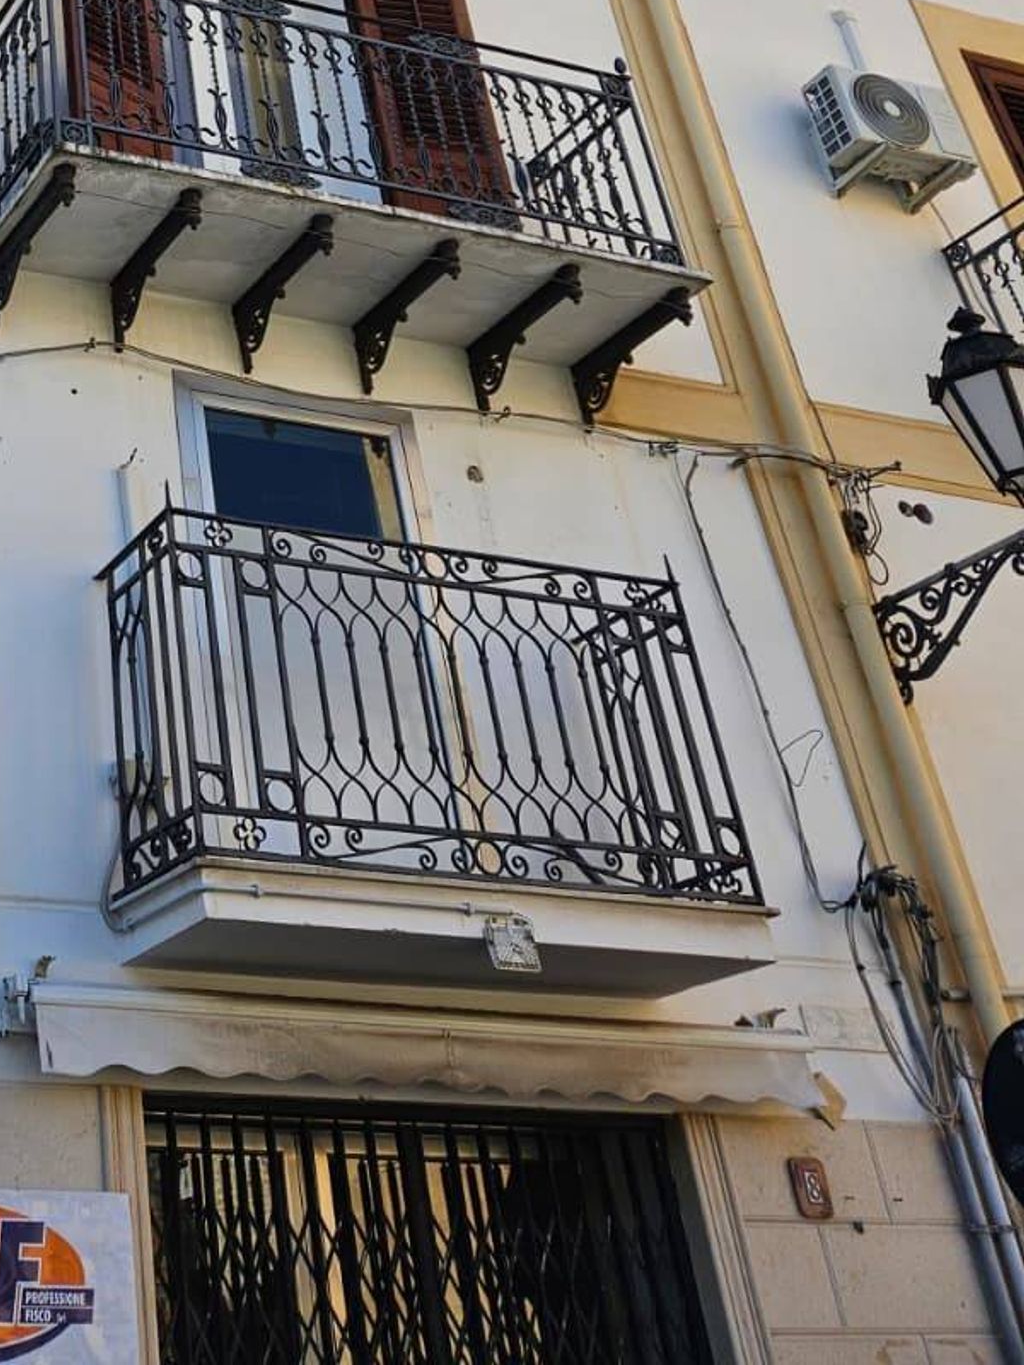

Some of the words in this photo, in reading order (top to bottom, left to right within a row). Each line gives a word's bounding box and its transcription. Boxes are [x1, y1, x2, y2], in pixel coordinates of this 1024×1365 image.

[807, 1173, 821, 1201] 8
[25, 1290, 86, 1306] PROFESSIONE
[25, 1308, 51, 1322] FISCO
